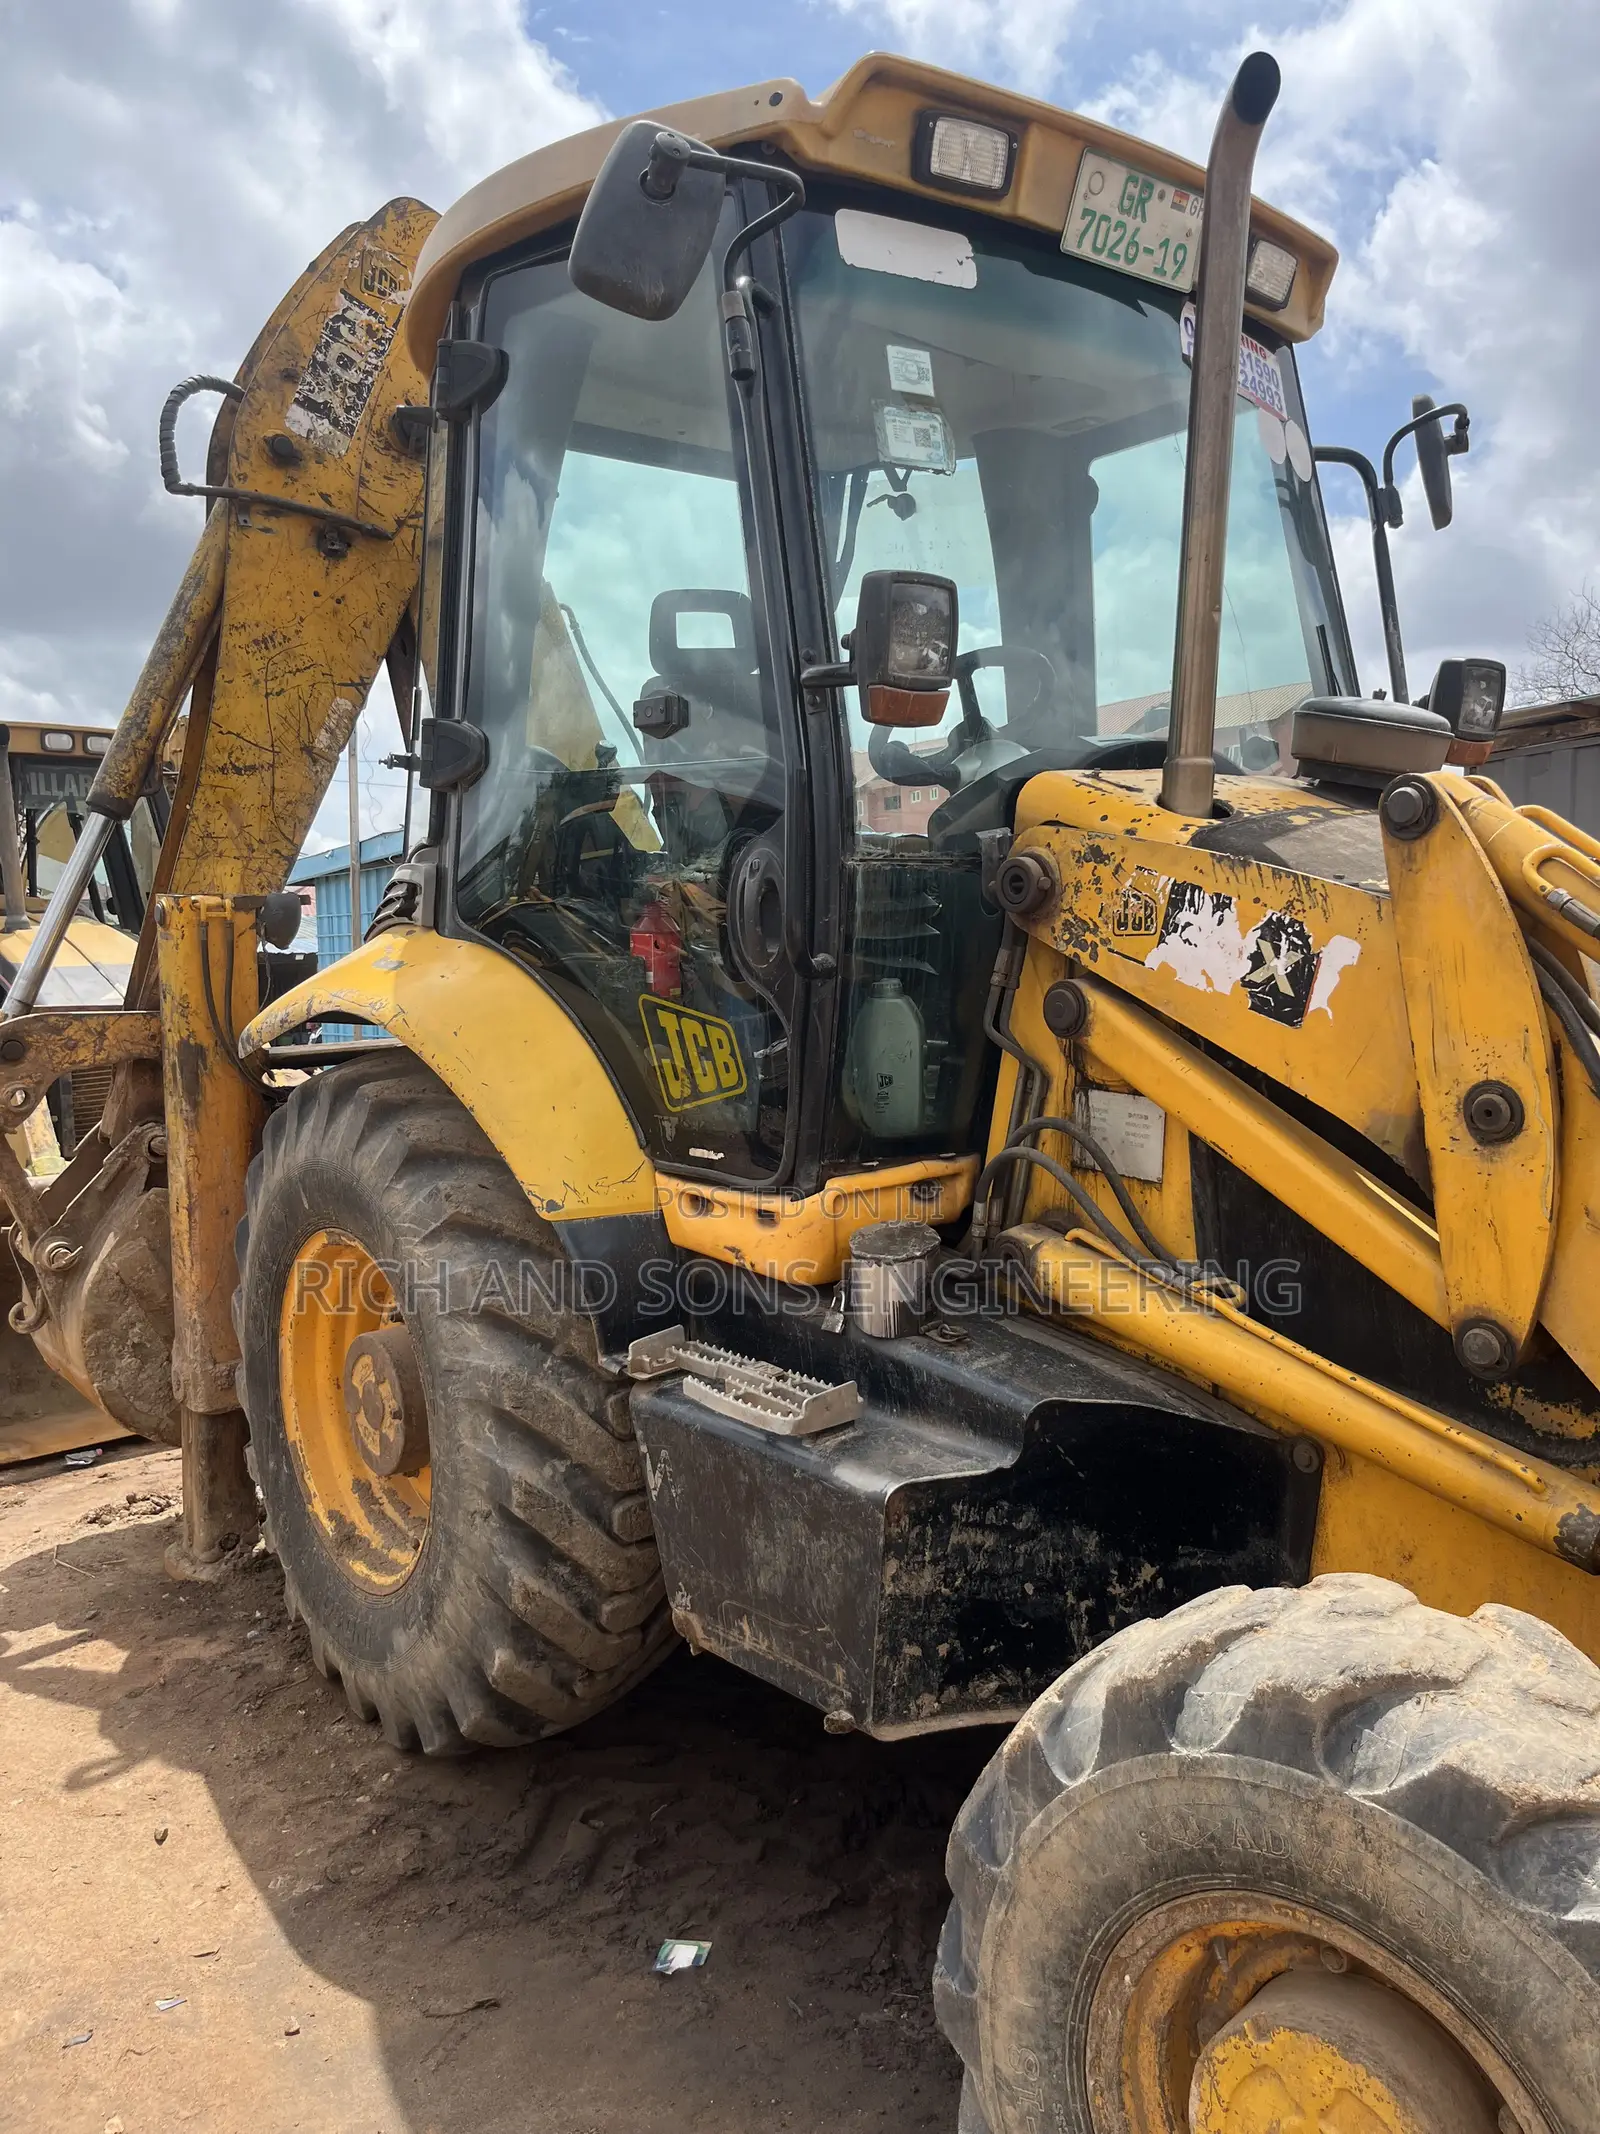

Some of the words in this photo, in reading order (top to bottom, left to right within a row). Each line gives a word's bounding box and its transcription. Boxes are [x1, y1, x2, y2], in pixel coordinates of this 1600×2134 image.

[1118, 174, 1155, 223] GR
[1077, 208, 1188, 280] 7026-19
[657, 1008, 739, 1100] JCB
[1231, 1817, 1466, 1959] ADVANCE
